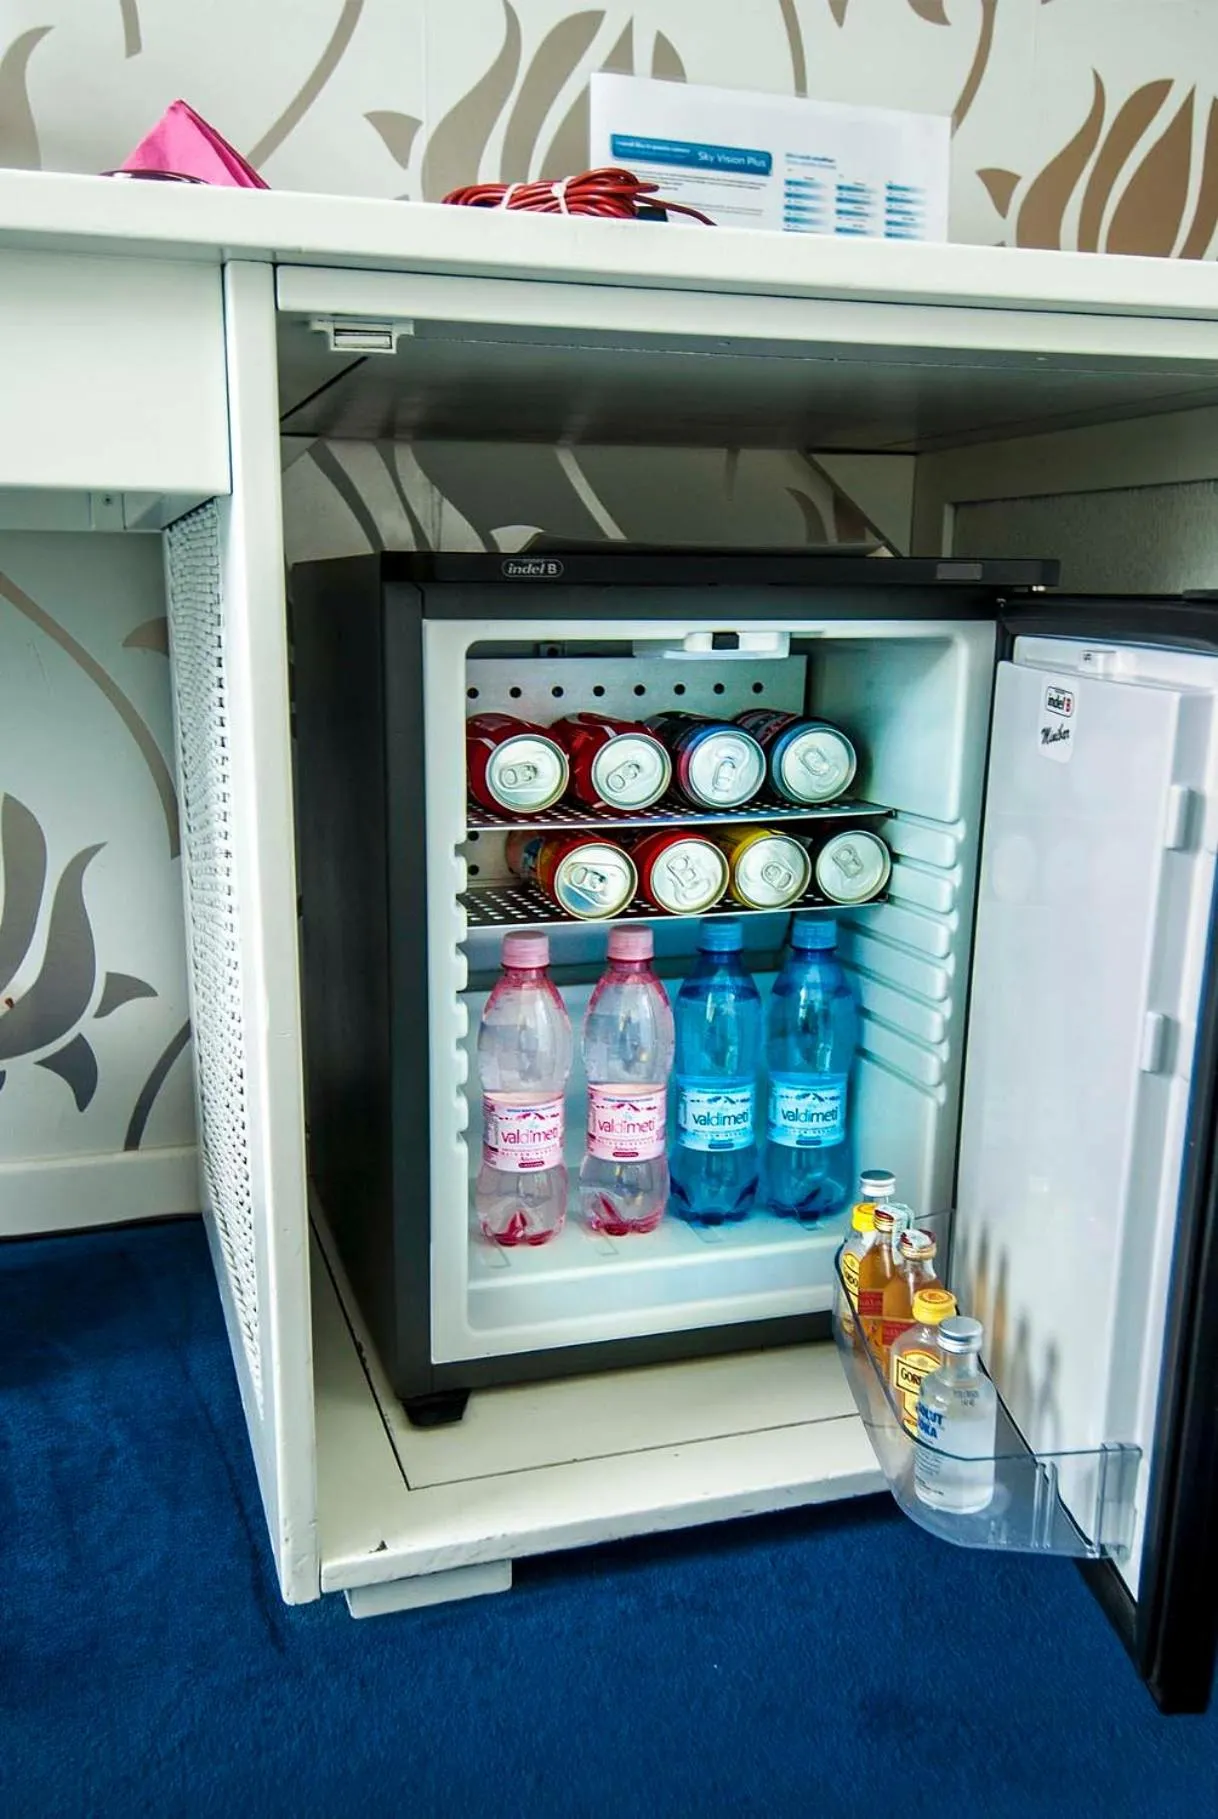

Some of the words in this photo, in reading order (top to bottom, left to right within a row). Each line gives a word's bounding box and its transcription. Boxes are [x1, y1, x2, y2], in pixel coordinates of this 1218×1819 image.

[697, 151, 715, 164] Sky
[716, 153, 746, 165] Vision
[747, 155, 767, 168] Plus
[508, 563, 546, 574] indel
[547, 563, 557, 574] B
